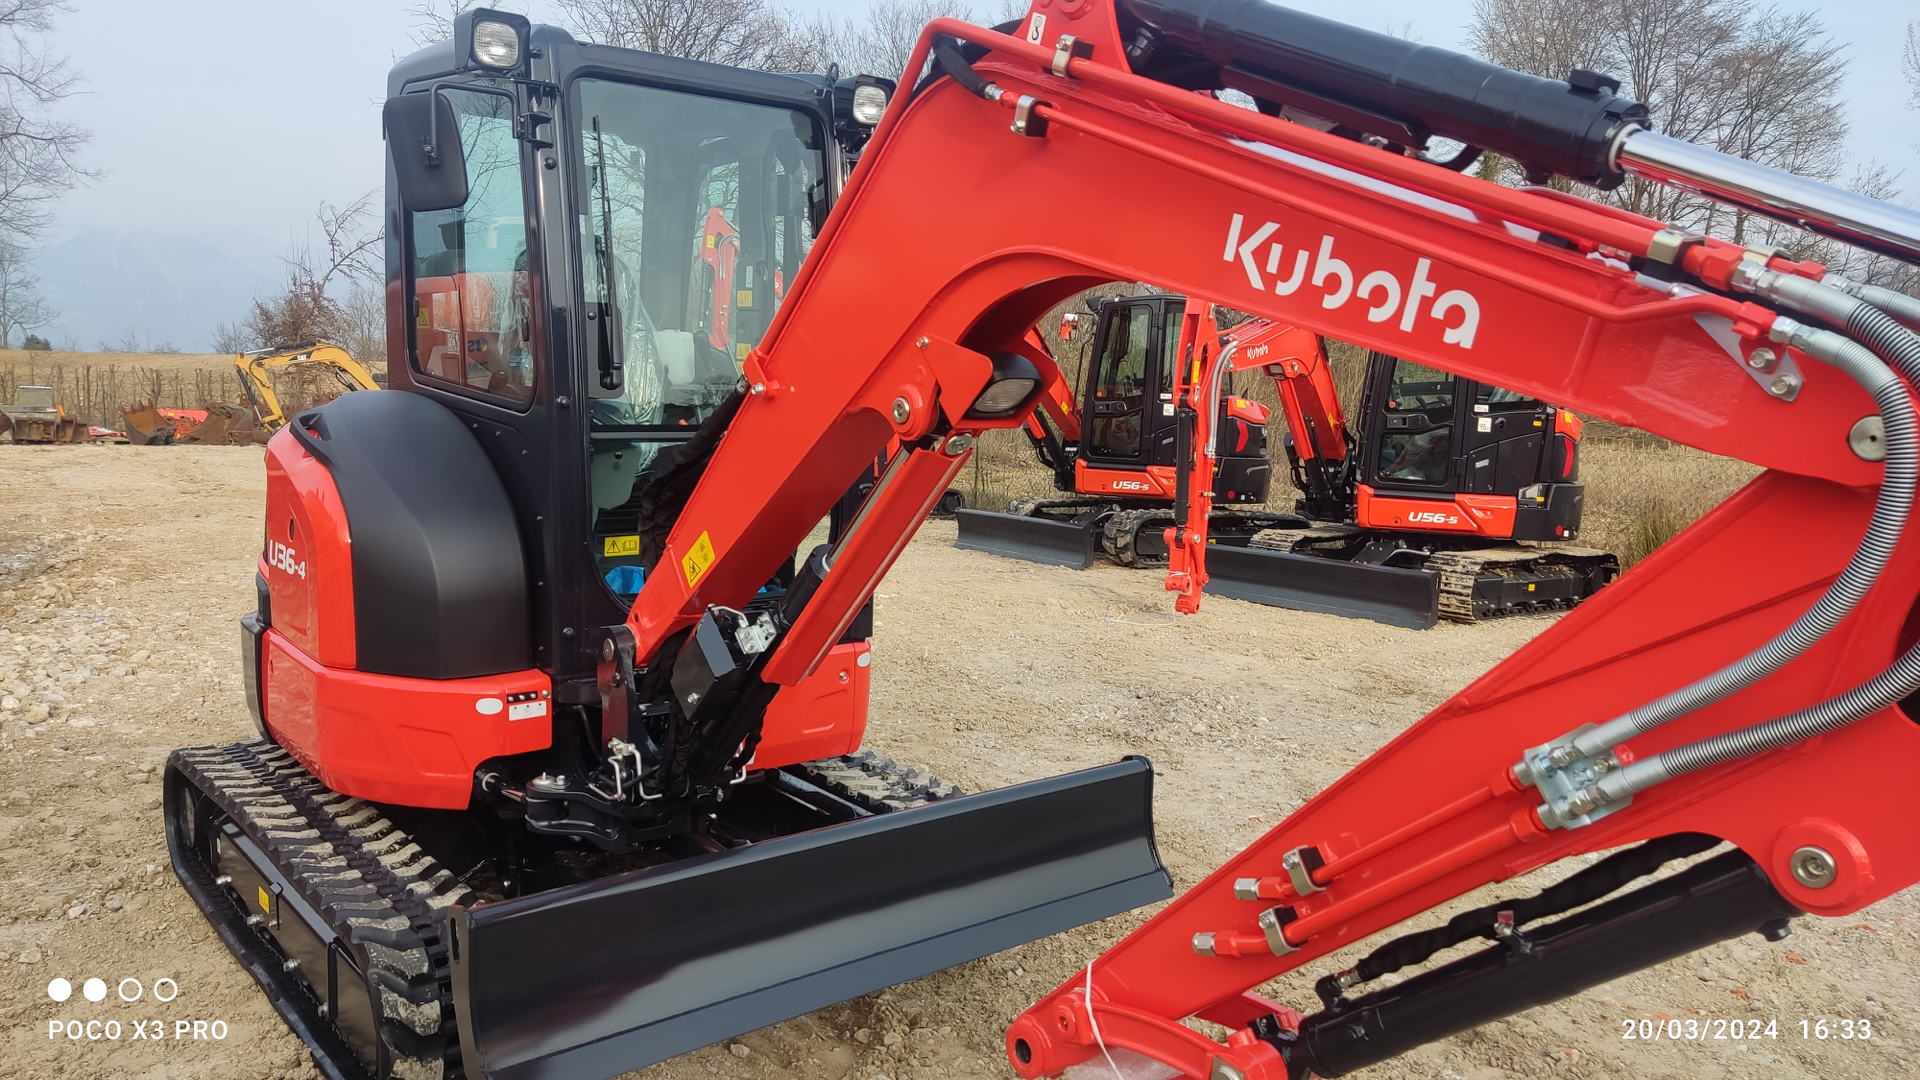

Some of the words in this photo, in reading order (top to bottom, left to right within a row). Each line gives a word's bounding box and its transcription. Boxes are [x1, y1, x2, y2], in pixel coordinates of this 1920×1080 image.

[1223, 213, 1480, 349] Kubota
[1408, 511, 1459, 524] U56-5
[269, 539, 306, 580] U36-4
